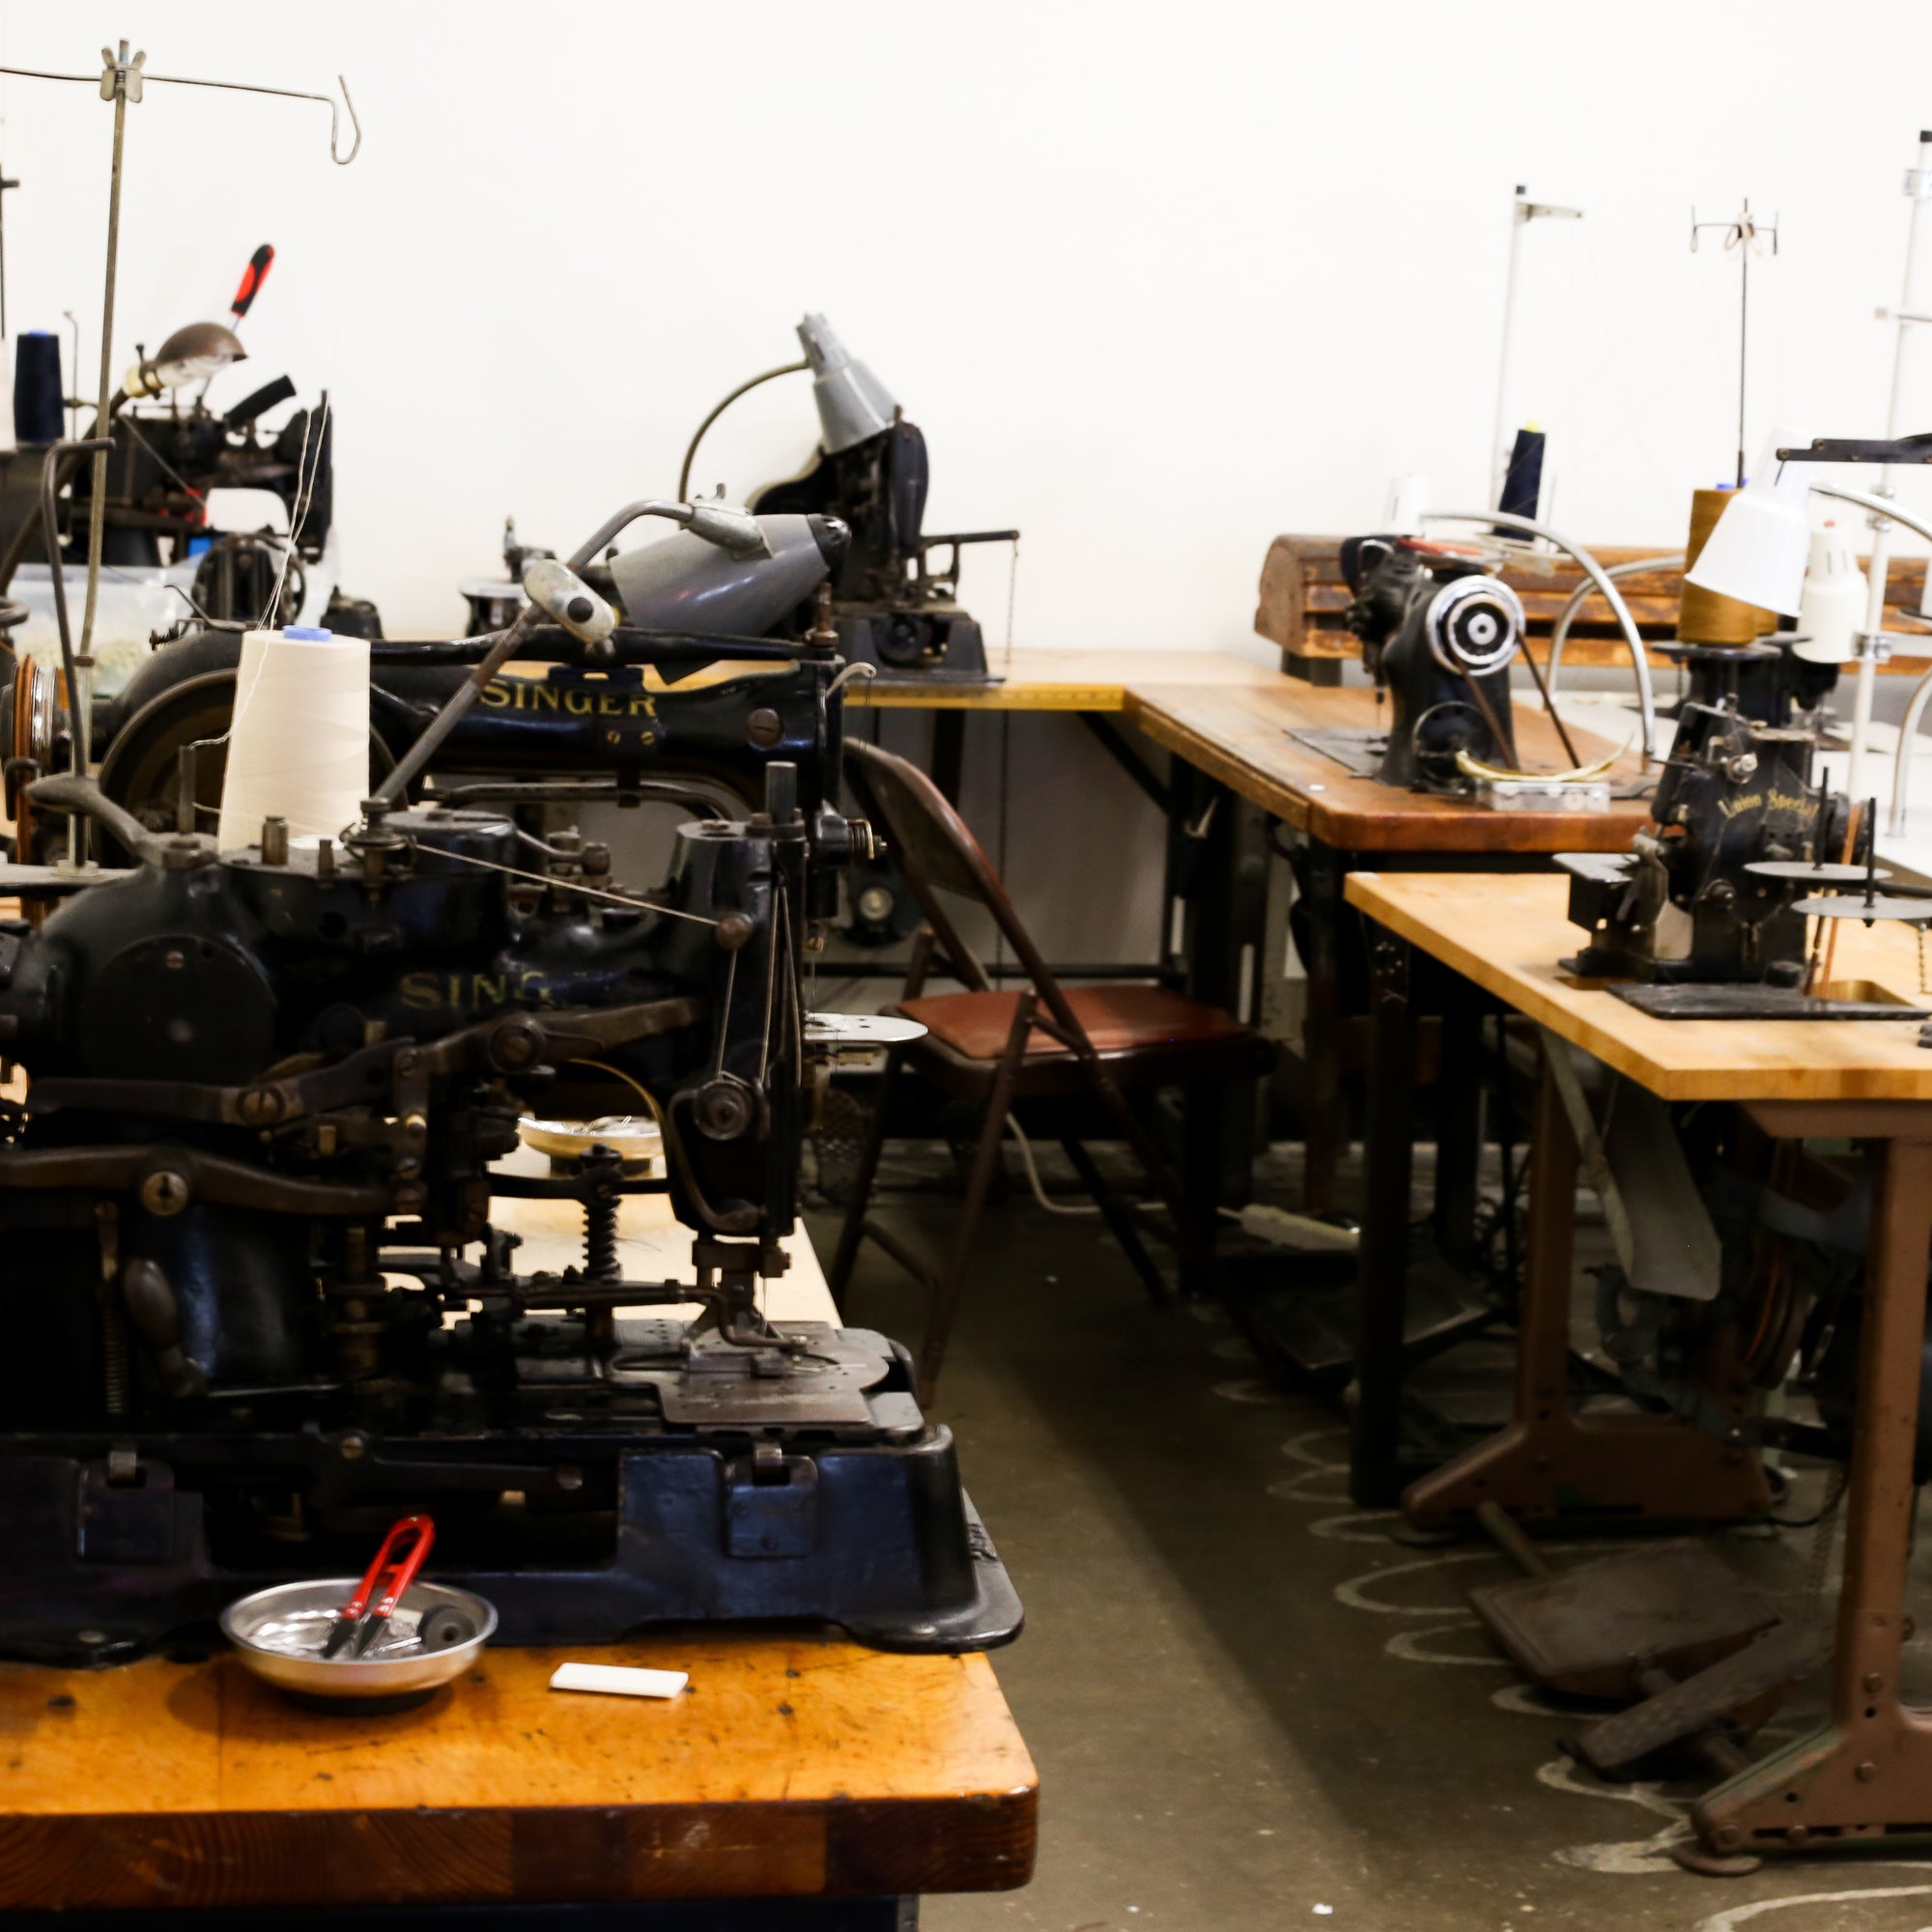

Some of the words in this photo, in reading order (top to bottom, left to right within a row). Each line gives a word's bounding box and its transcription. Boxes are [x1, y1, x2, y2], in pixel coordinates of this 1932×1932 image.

[479, 677, 658, 718] SINGER
[1717, 792, 1763, 819] Union
[1767, 787, 1821, 818] Special
